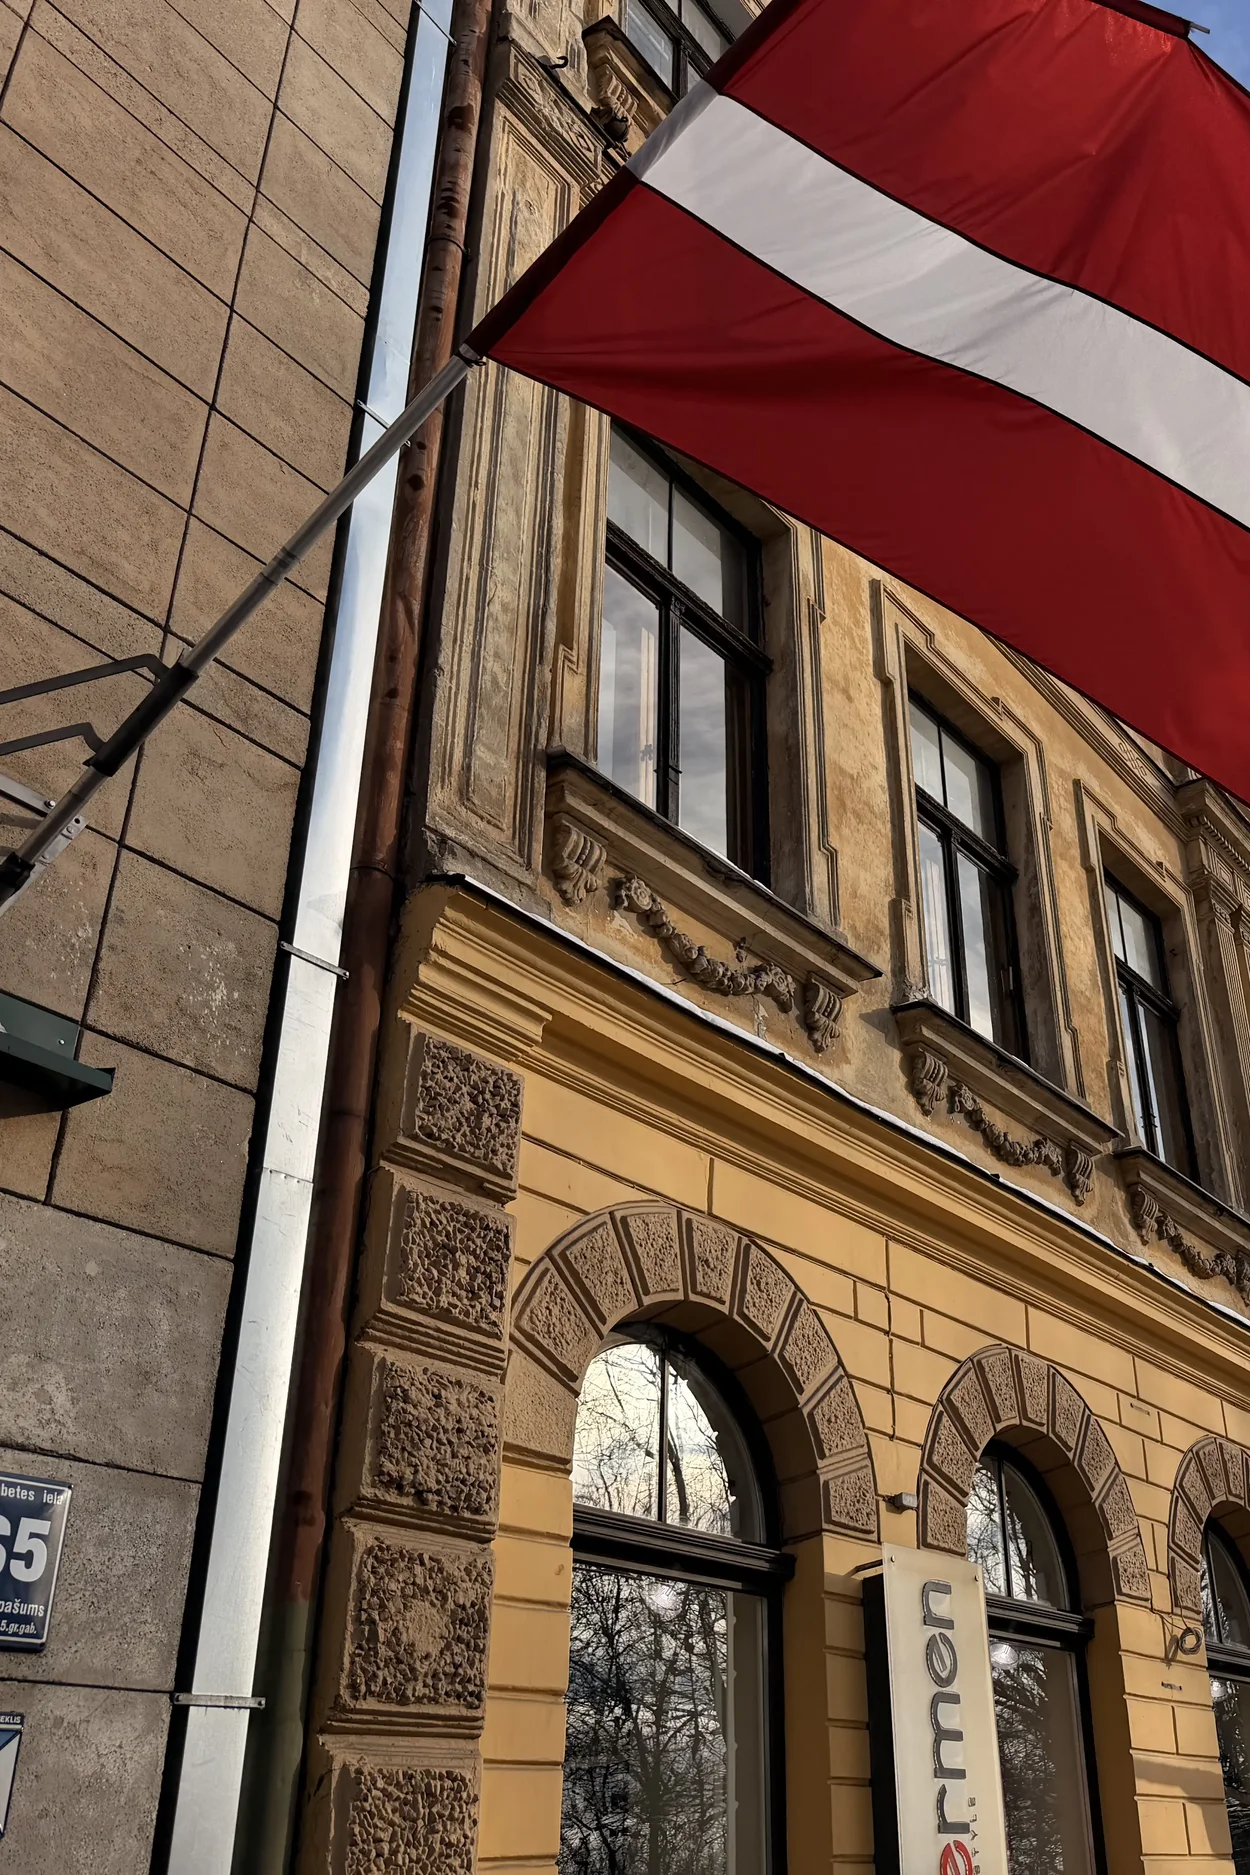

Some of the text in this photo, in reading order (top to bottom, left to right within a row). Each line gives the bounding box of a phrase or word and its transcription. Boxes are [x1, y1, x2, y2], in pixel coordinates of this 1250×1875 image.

[1, 1482, 63, 1505] betes iela
[0, 1515, 51, 1582] 5
